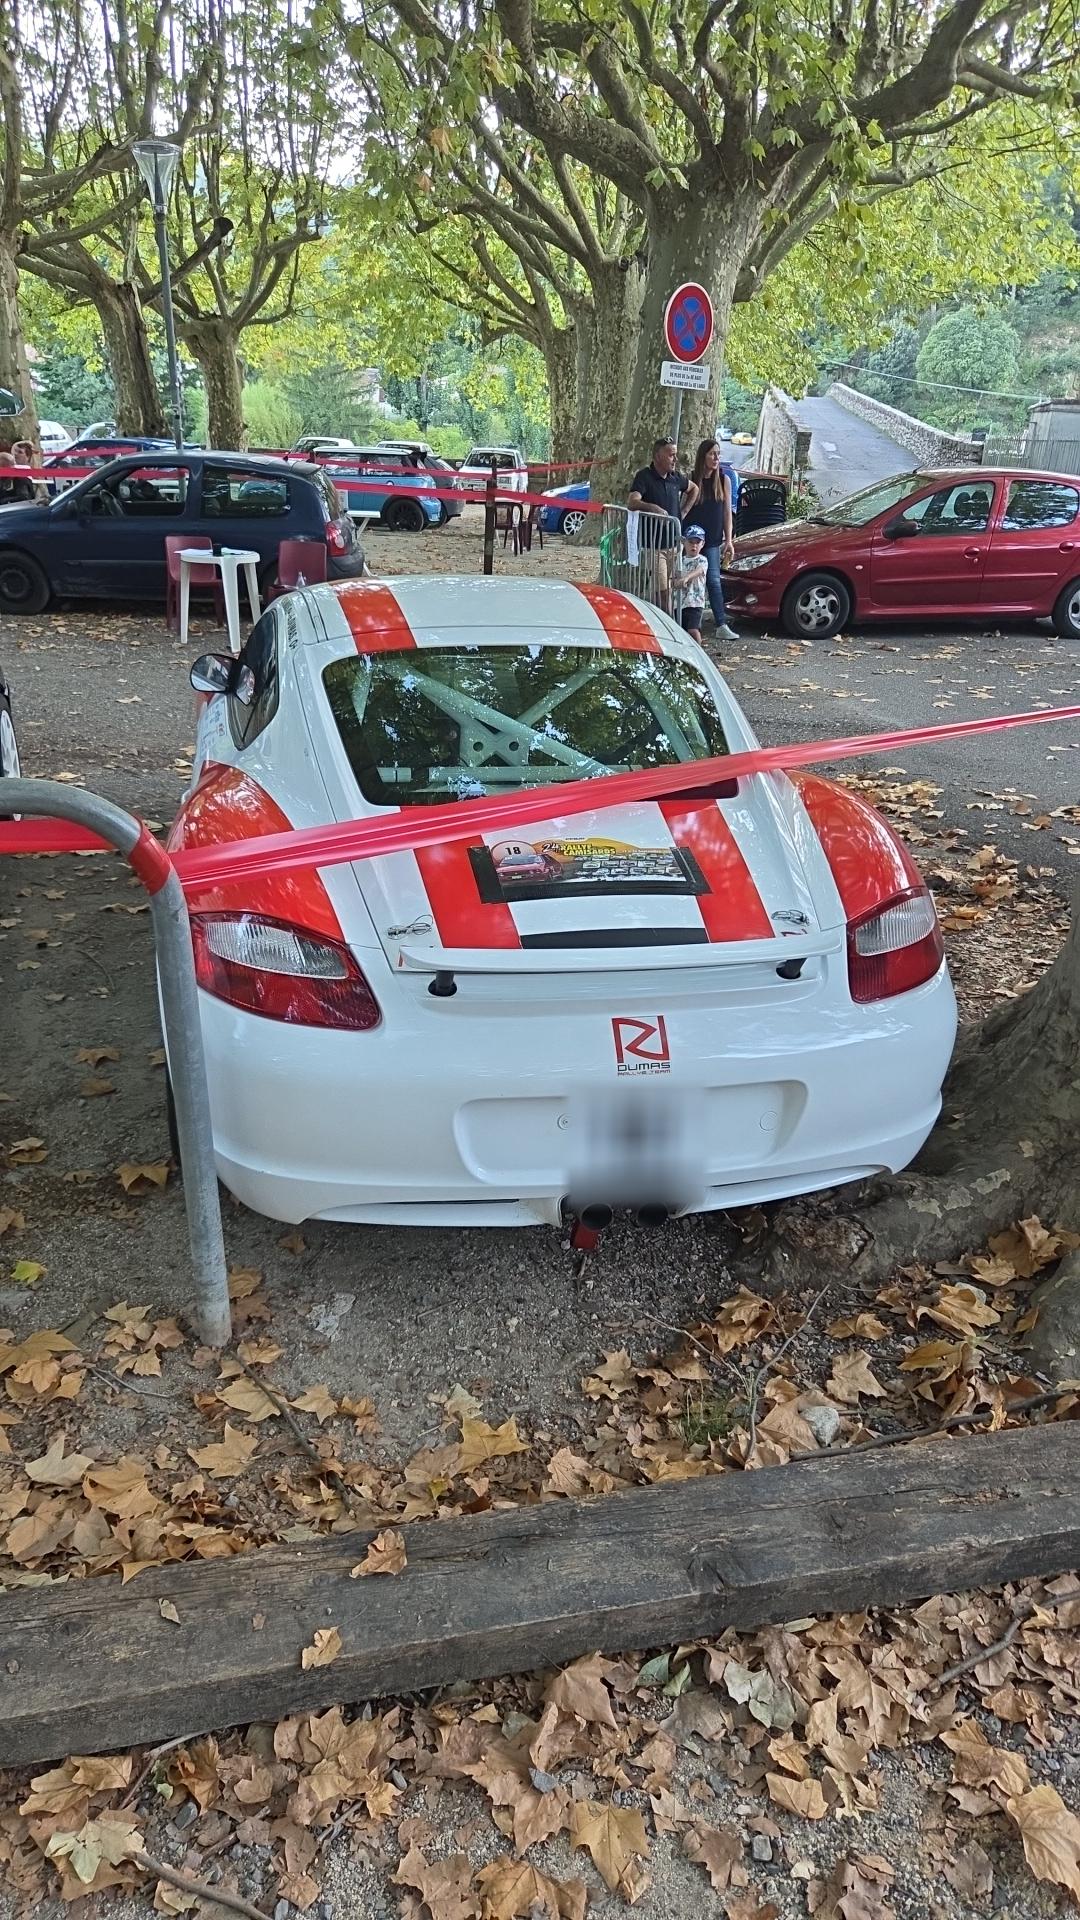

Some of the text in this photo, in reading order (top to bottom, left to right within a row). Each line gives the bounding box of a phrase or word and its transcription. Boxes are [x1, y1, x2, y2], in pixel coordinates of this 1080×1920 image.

[505, 846, 521, 855] 18
[564, 848, 616, 856] CAMISARDS
[617, 1062, 671, 1072] DUMAS
